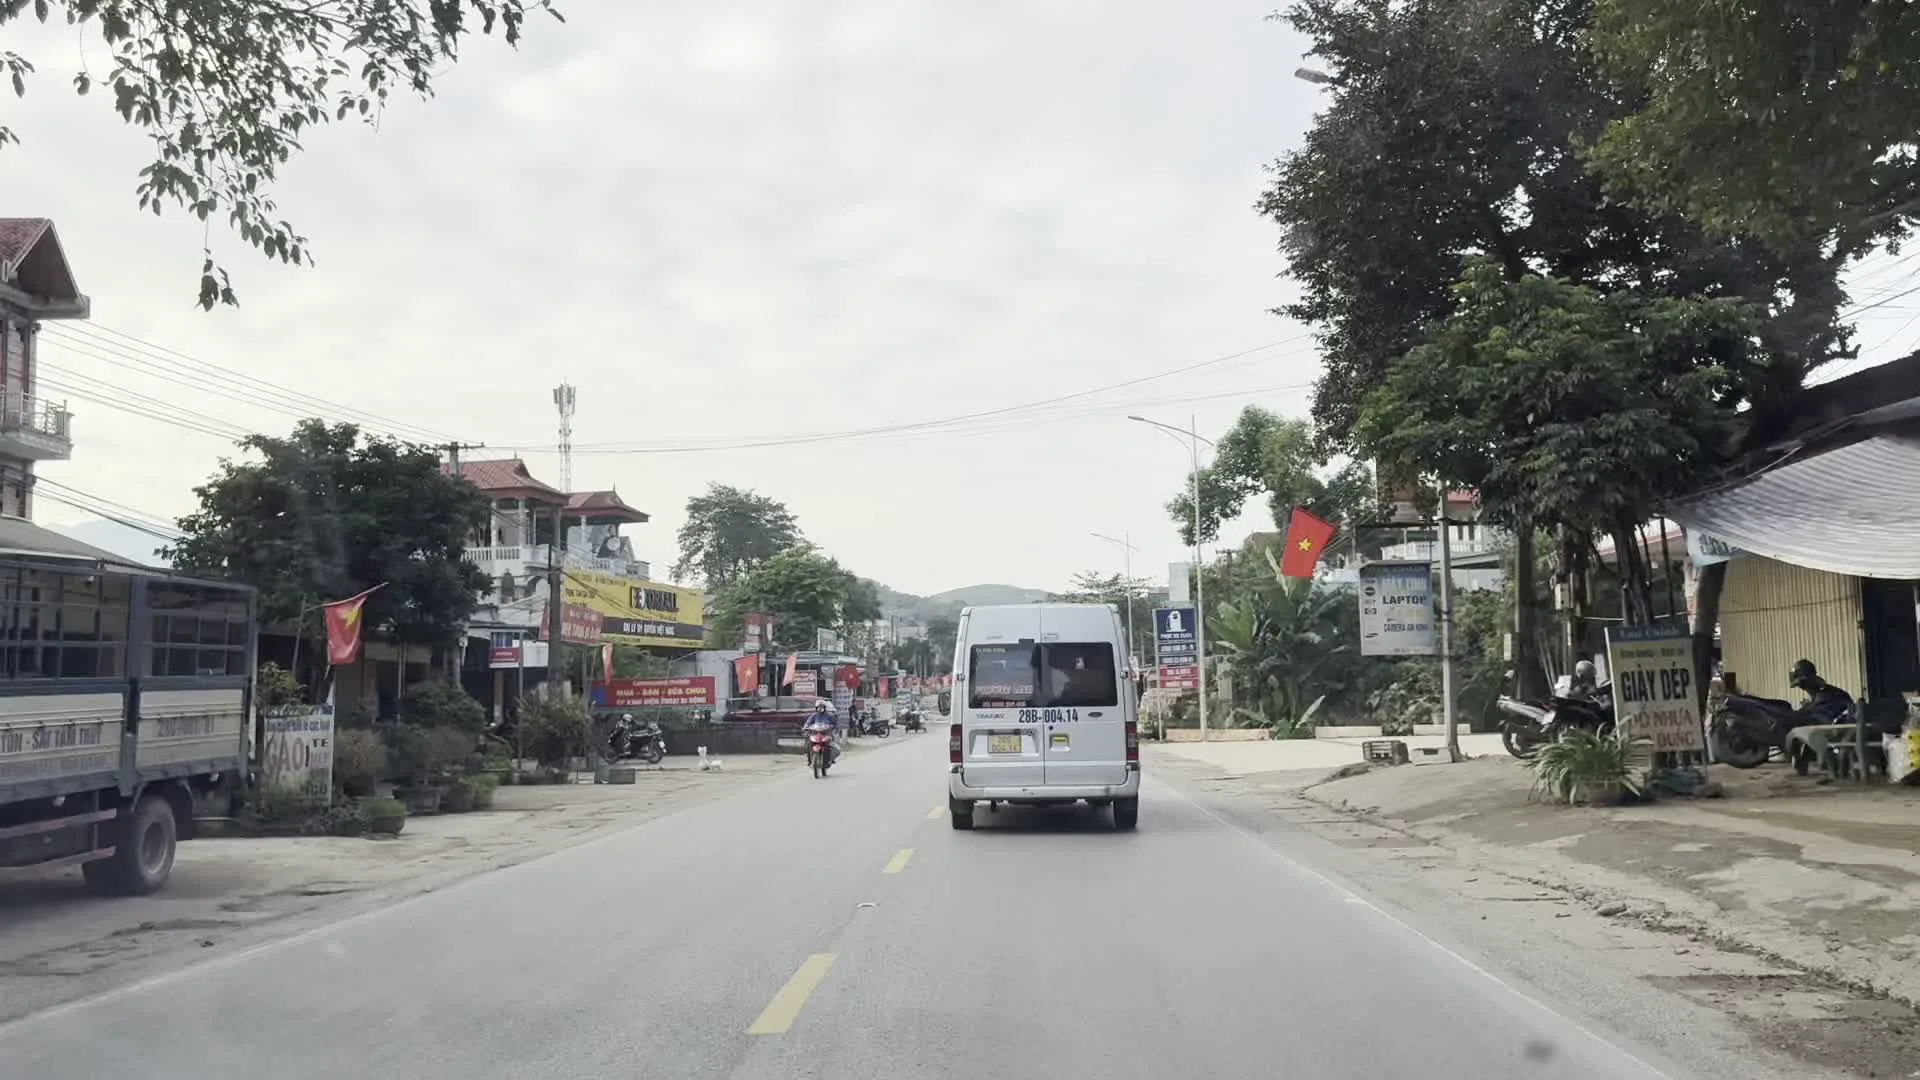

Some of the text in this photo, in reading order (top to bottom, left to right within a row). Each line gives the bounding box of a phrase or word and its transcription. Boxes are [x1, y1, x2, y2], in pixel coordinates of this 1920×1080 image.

[1383, 595, 1427, 605] LAPTOP
[1621, 661, 1689, 702] GIÀY DÉP
